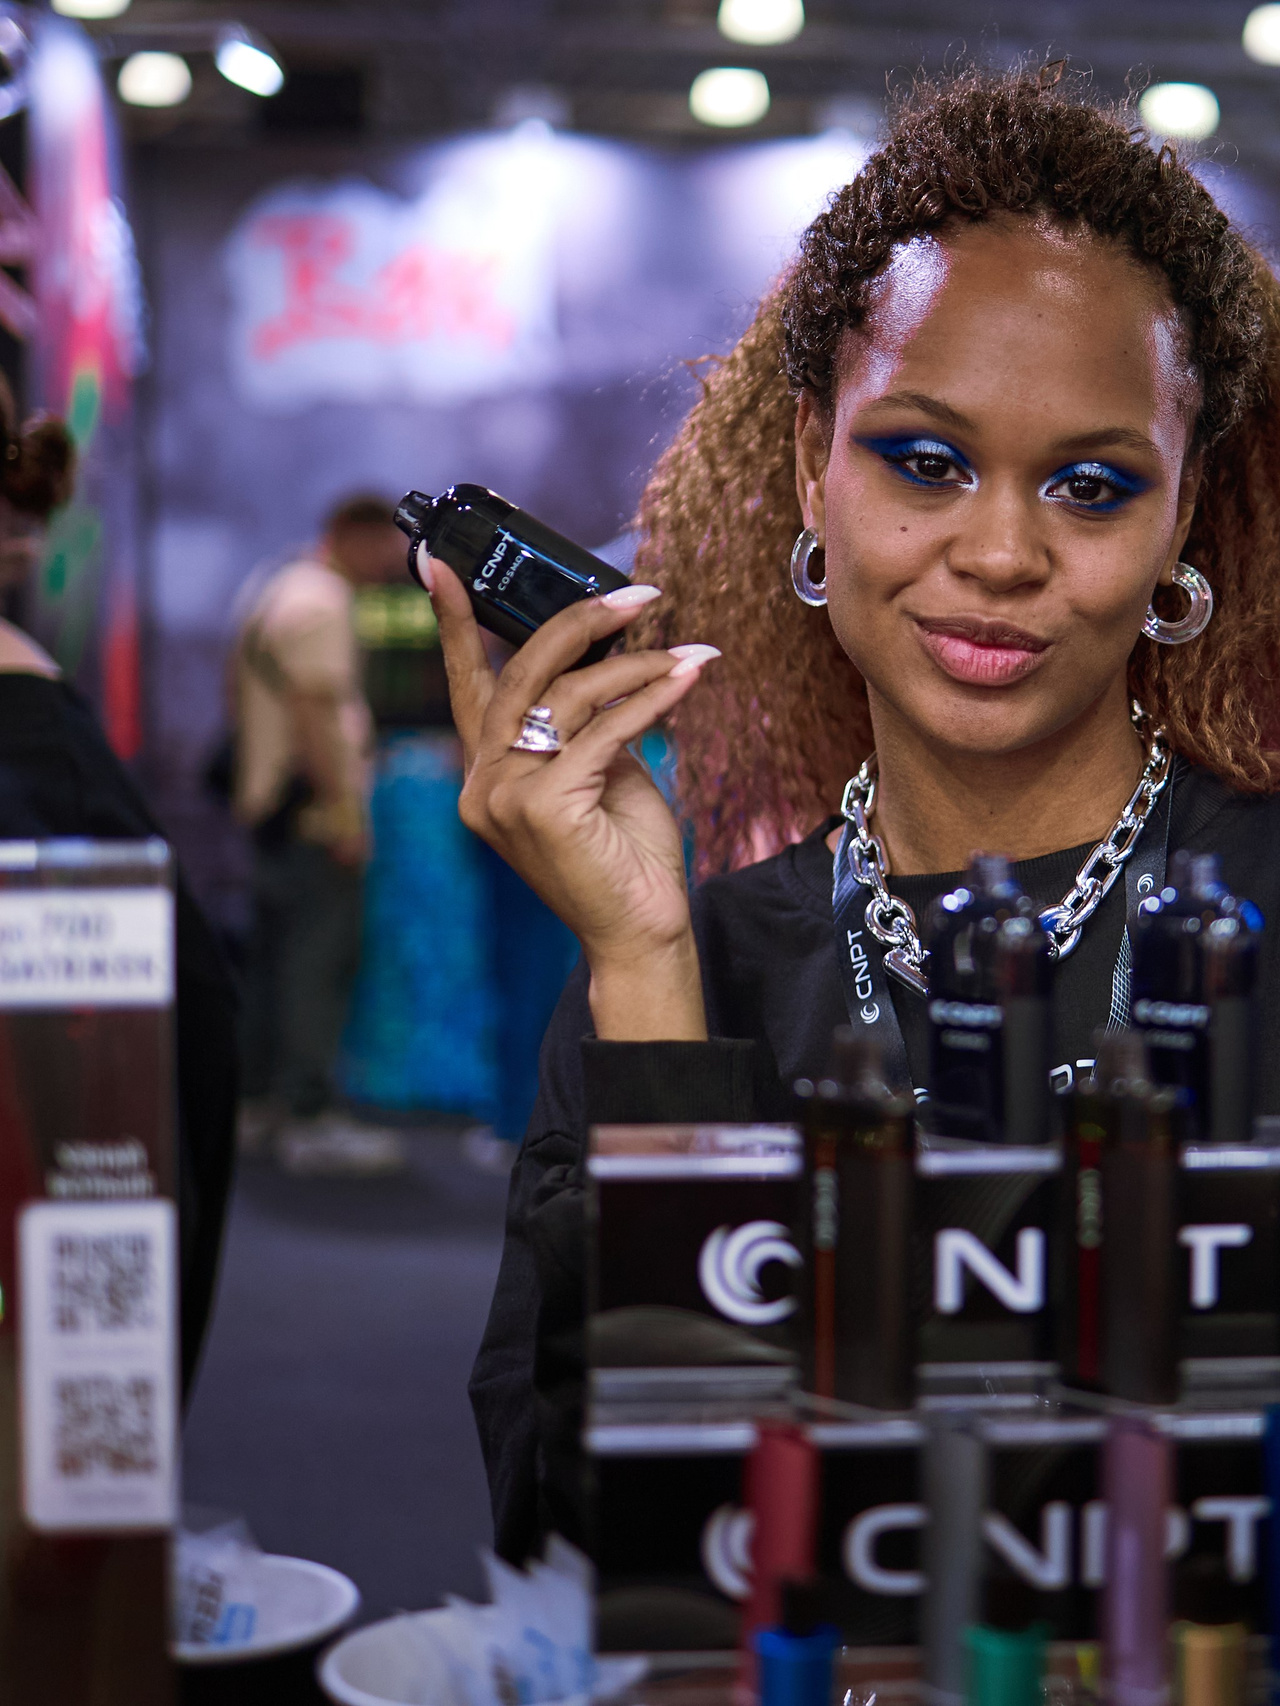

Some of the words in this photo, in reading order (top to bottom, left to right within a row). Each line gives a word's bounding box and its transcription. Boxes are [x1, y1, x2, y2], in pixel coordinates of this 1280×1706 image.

[482, 531, 515, 579] CNPT
[498, 555, 524, 591] COSMO
[847, 929, 873, 1000] CNPT
